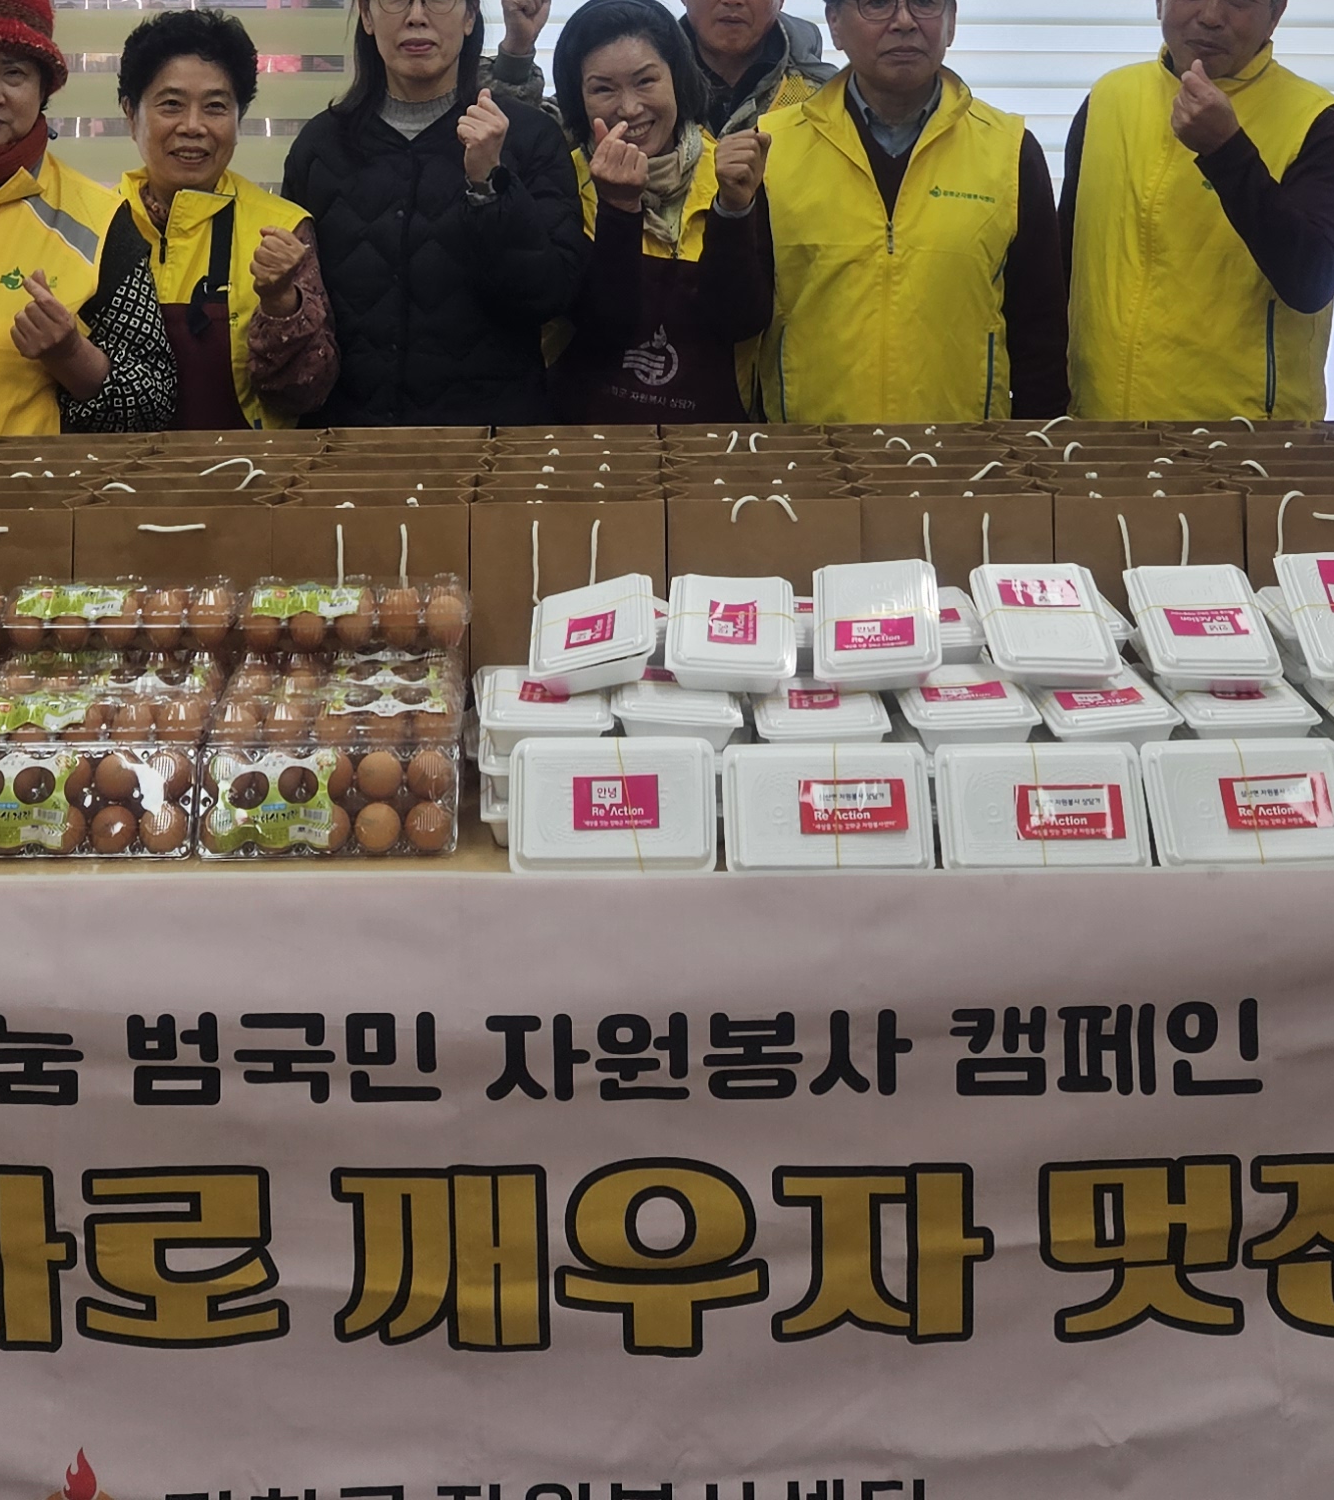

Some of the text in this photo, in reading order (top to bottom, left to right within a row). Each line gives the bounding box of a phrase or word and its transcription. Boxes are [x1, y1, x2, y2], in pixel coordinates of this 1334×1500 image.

[597, 786, 617, 799] 안녕
[1261, 788, 1285, 796] 자원봉사
[1055, 798, 1080, 806] 자원봉사
[1082, 798, 1101, 806] 상담가
[592, 806, 644, 816] Re Action
[834, 811, 871, 820] Action
[1258, 806, 1295, 816] Action
[1050, 816, 1087, 826] Action
[126, 1009, 443, 1106] 범국민
[484, 1008, 914, 1103] 자원봉사
[948, 997, 1265, 1098] 캠페인
[334, 1157, 995, 1358] 깨우자
